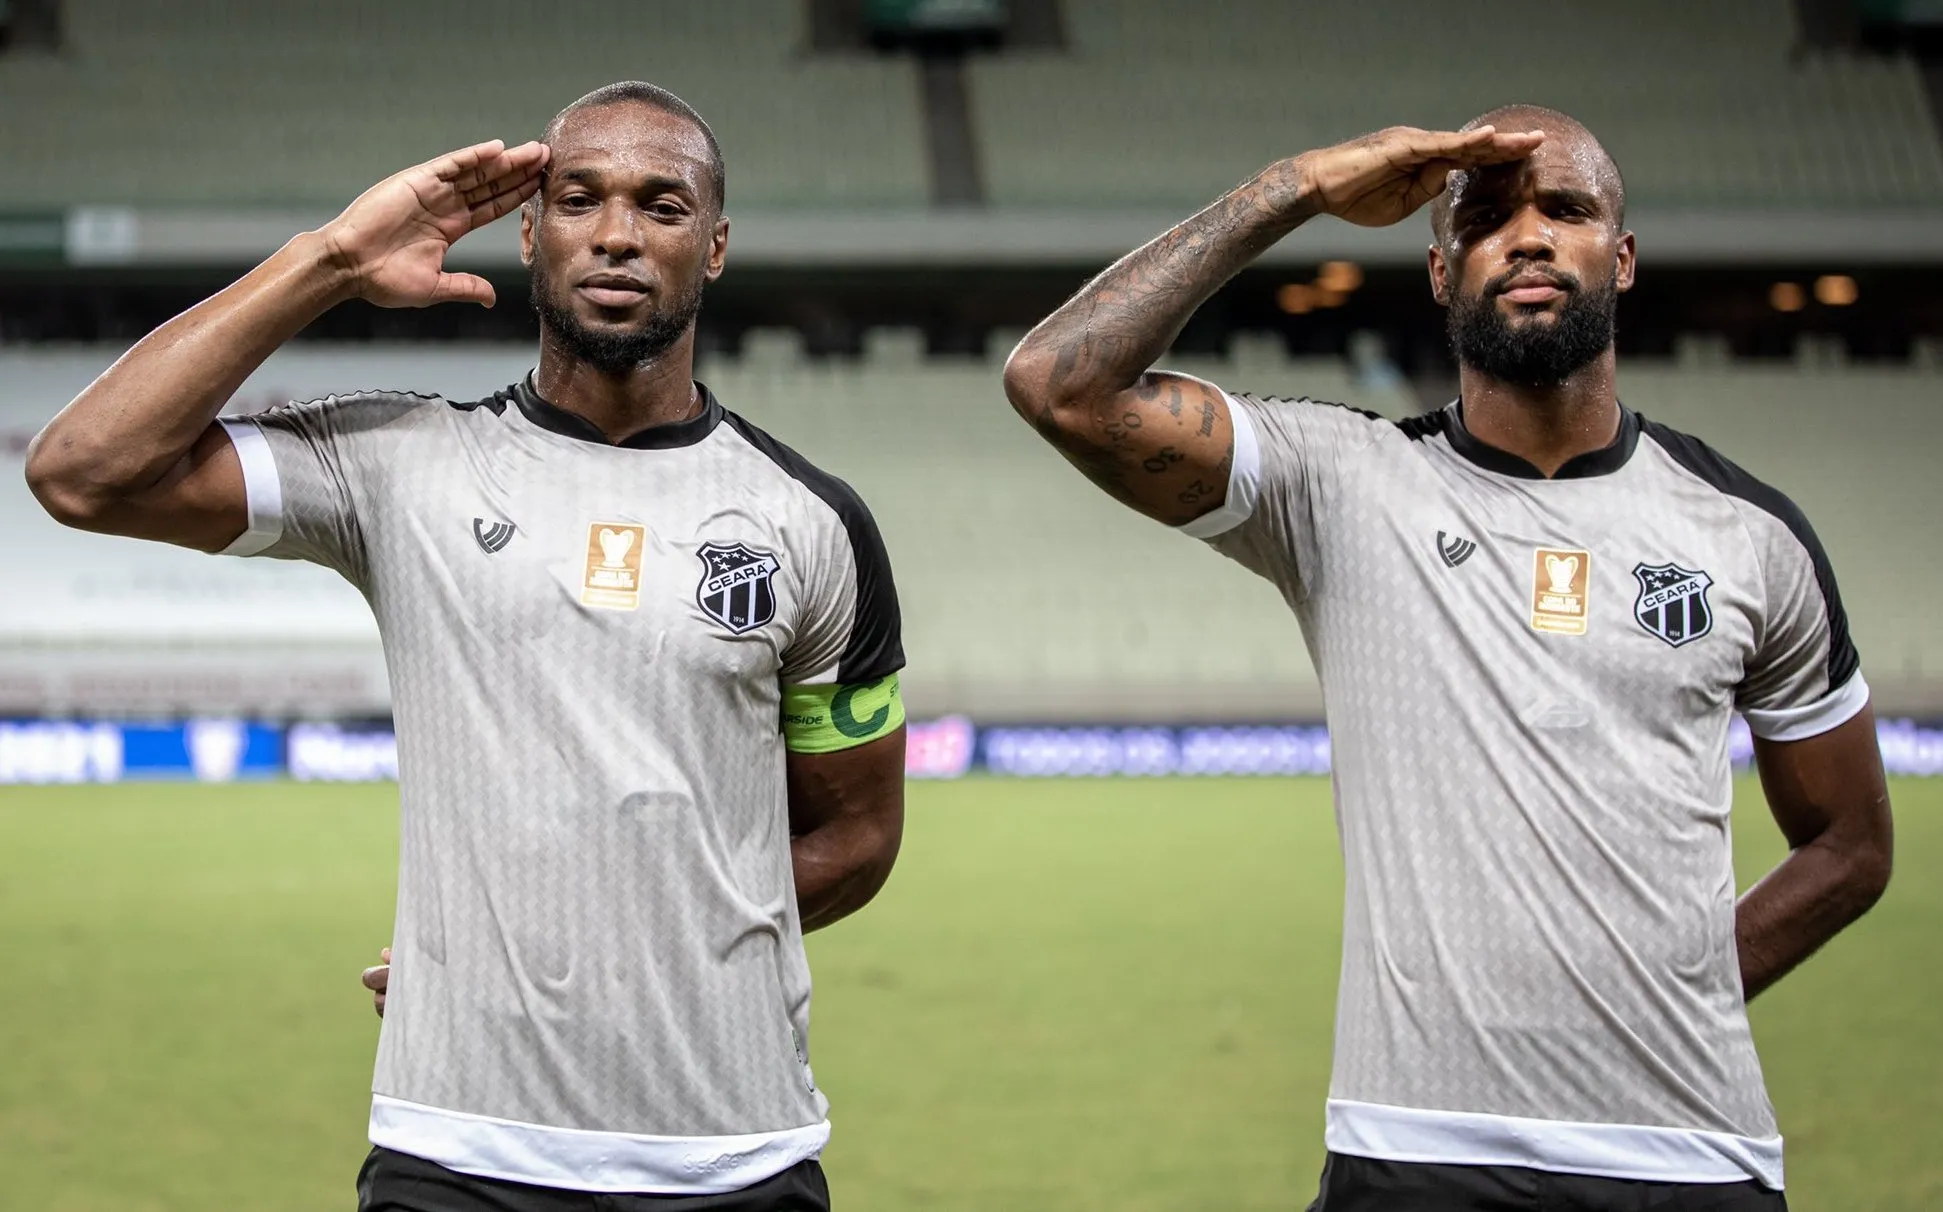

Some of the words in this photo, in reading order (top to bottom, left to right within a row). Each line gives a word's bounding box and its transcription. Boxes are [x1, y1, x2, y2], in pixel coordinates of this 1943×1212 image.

[708, 562, 768, 592] CEARÁ
[1644, 579, 1701, 608] CEARÁ
[830, 679, 890, 738] C
